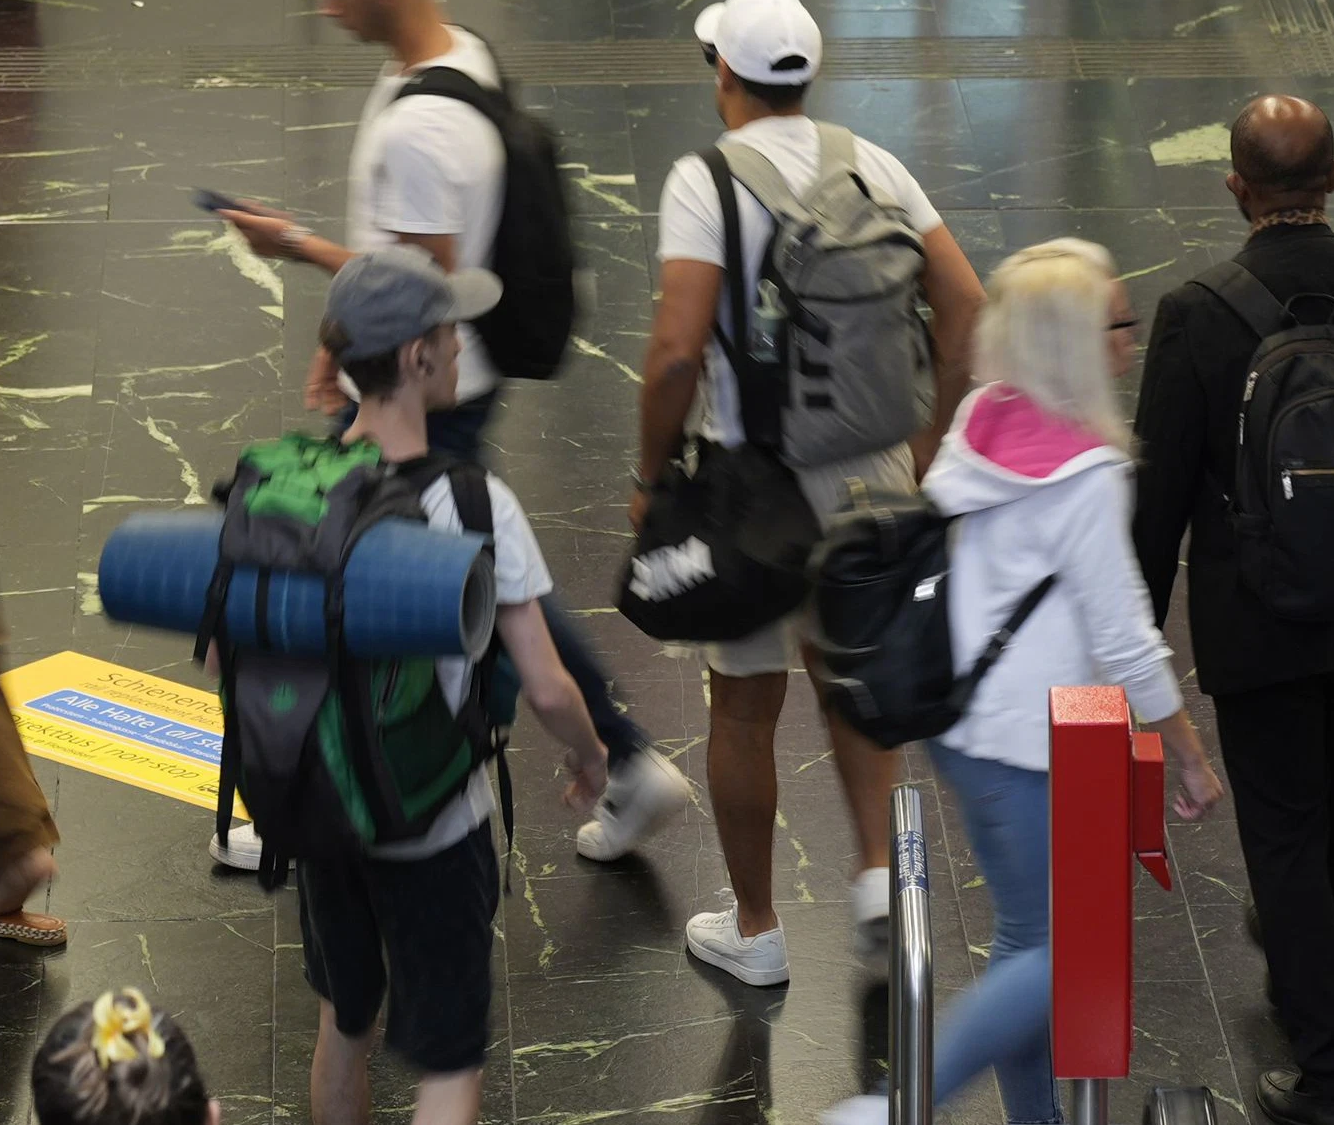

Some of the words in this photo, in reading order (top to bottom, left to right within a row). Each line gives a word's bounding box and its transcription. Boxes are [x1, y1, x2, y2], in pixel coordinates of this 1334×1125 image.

[97, 672, 223, 716] Schienene
[55, 695, 100, 712] Alle
[99, 707, 156, 729] Halte
[165, 730, 203, 741] all
[192, 738, 223, 755] sto
[105, 748, 200, 779] non-stop
